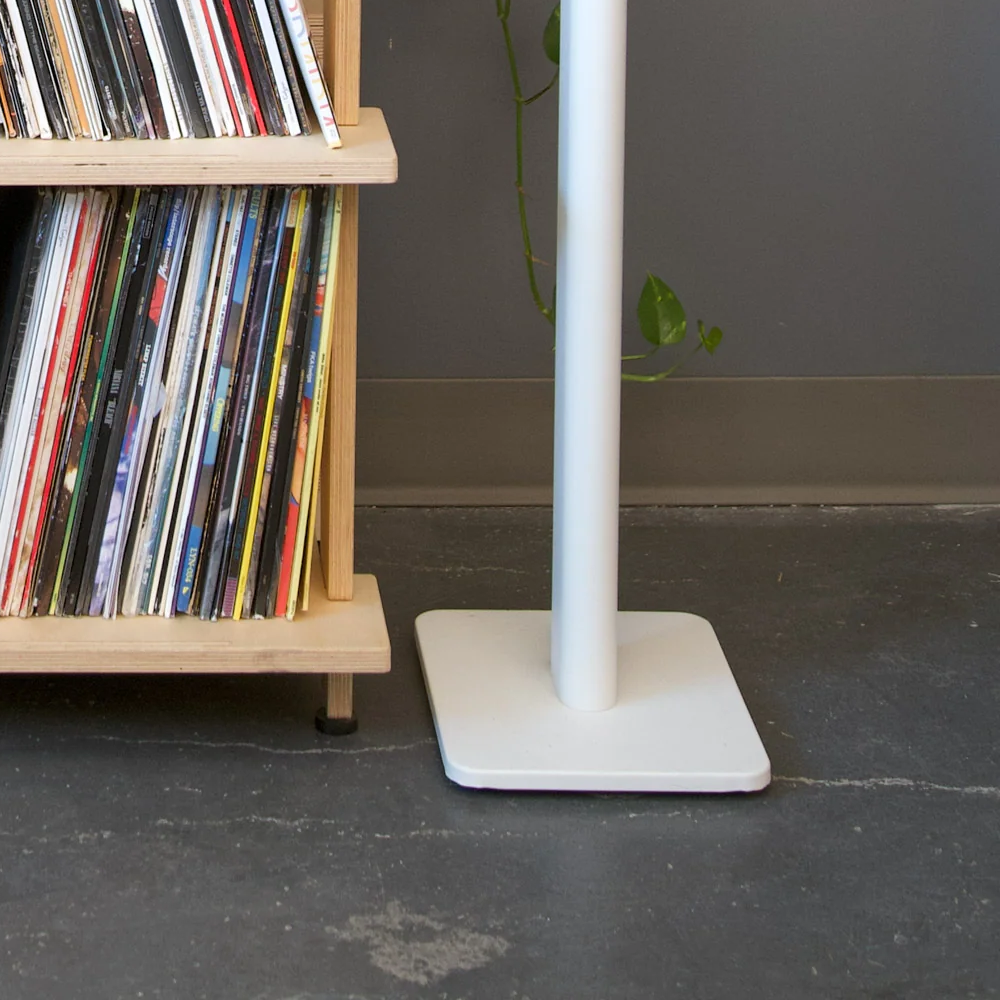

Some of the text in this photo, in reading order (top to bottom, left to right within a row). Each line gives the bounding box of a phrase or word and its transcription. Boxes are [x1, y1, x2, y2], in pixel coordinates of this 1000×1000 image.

[29, 30, 37, 43] THE
[248, 188, 262, 219] CULTS
[141, 343, 151, 362] LIMP
[305, 350, 316, 383] FKA twigs
[276, 363, 288, 400] MINISTRY
